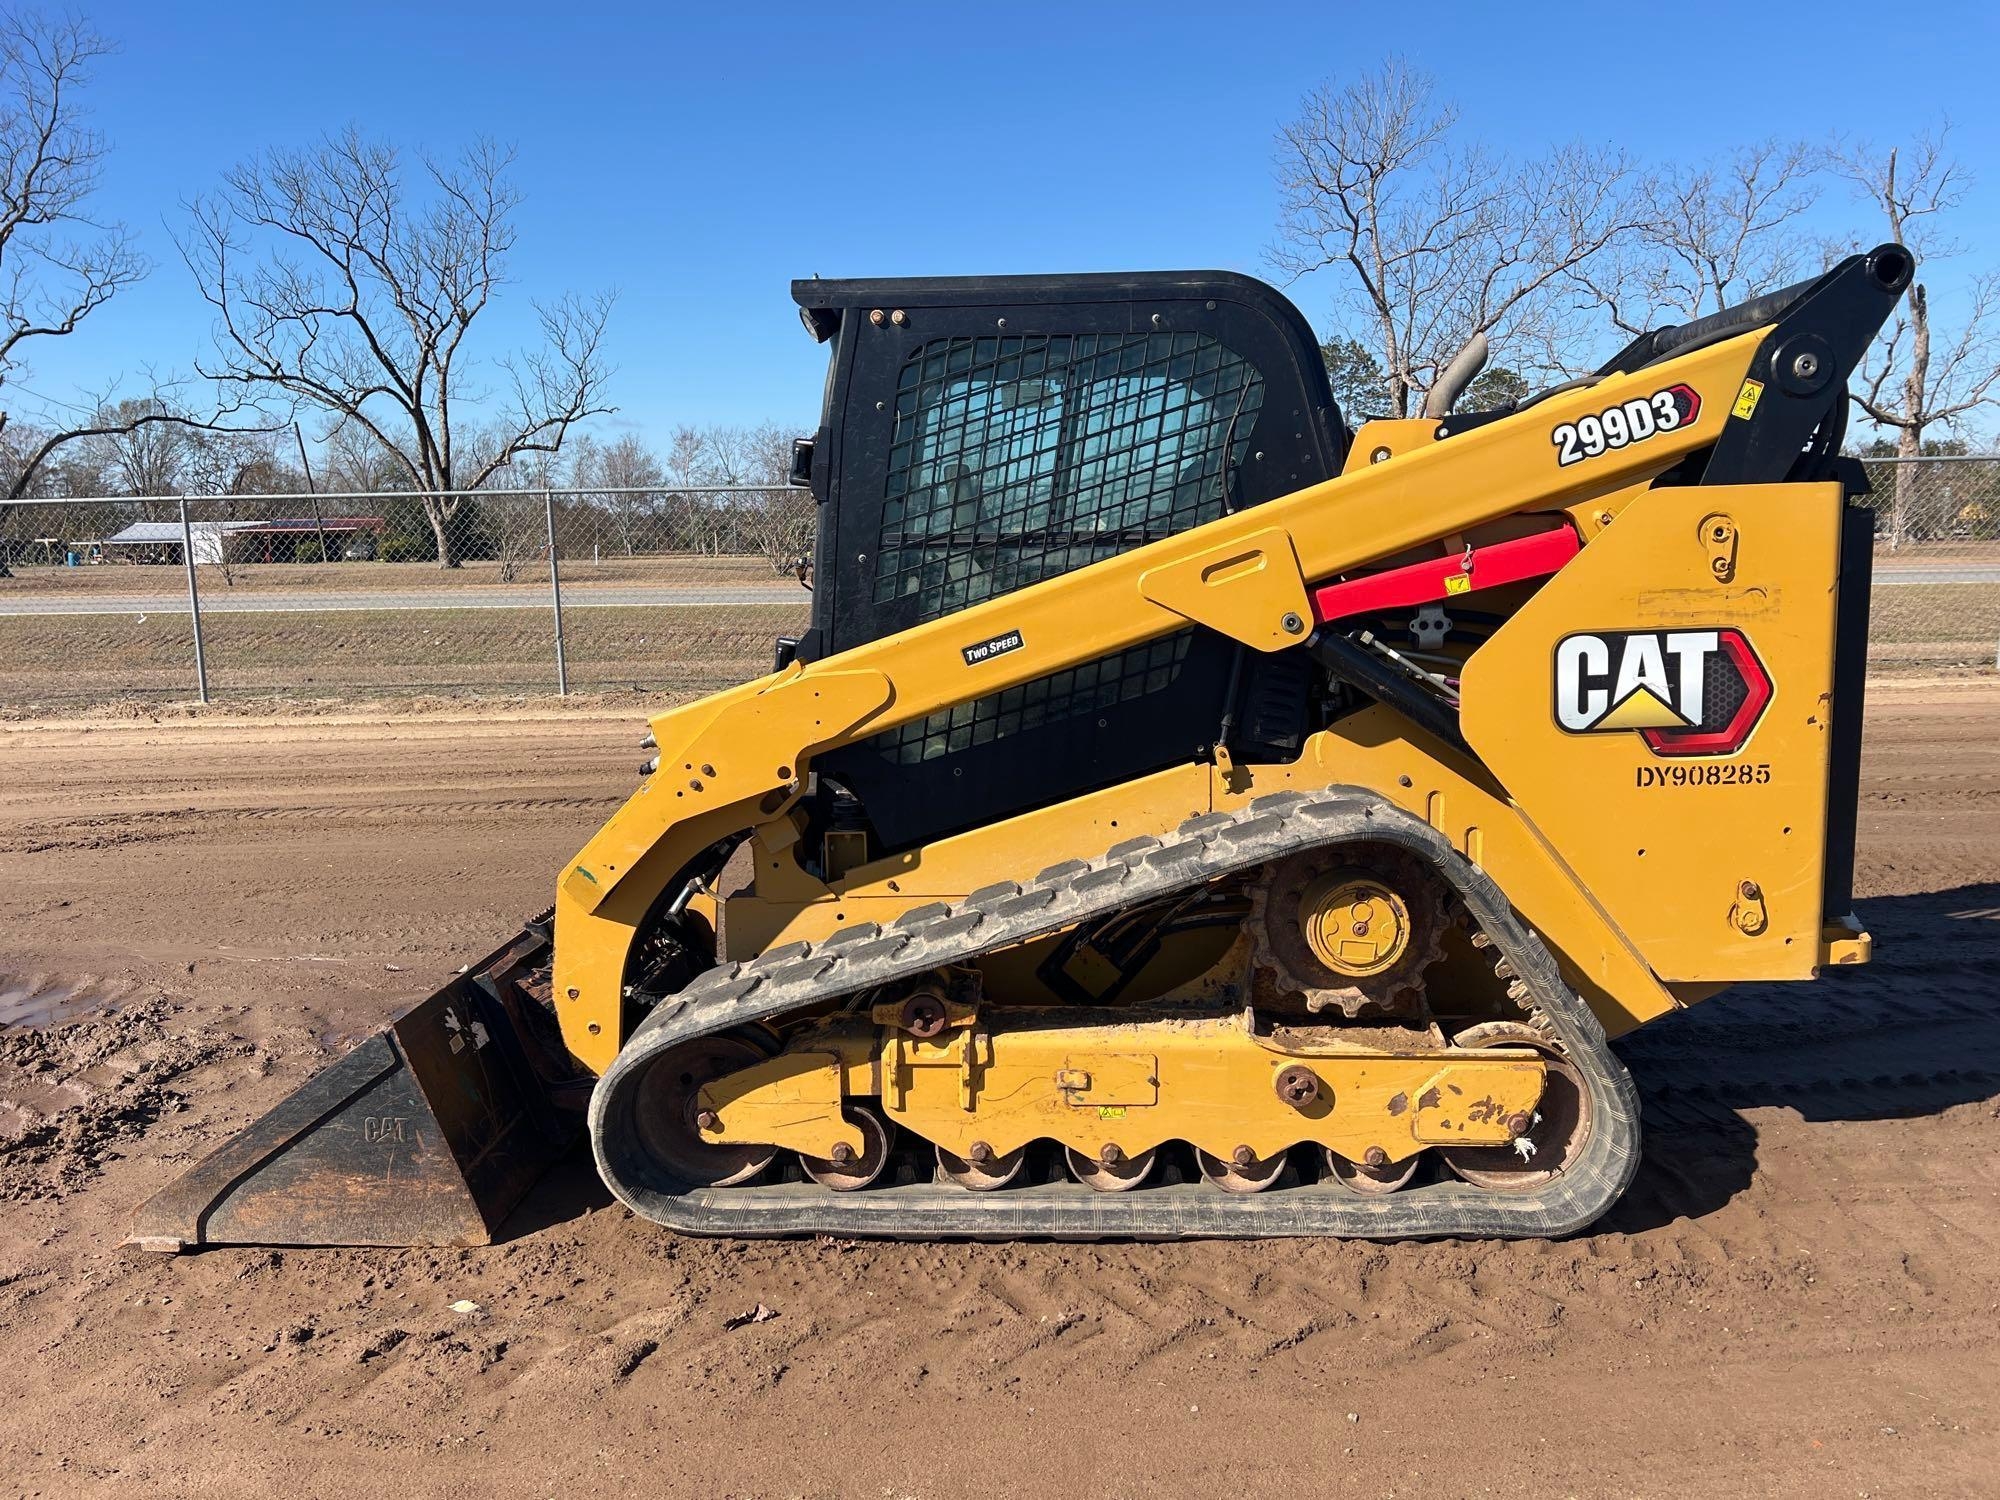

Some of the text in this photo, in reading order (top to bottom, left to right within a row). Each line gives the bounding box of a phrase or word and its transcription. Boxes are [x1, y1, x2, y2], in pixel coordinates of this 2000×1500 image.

[1553, 390, 1681, 464] 299D3
[966, 636, 1018, 662] TWO SPEED
[1556, 632, 1719, 730] CAT
[1637, 765, 1771, 787] DY908285
[364, 1116, 408, 1143] CAT
